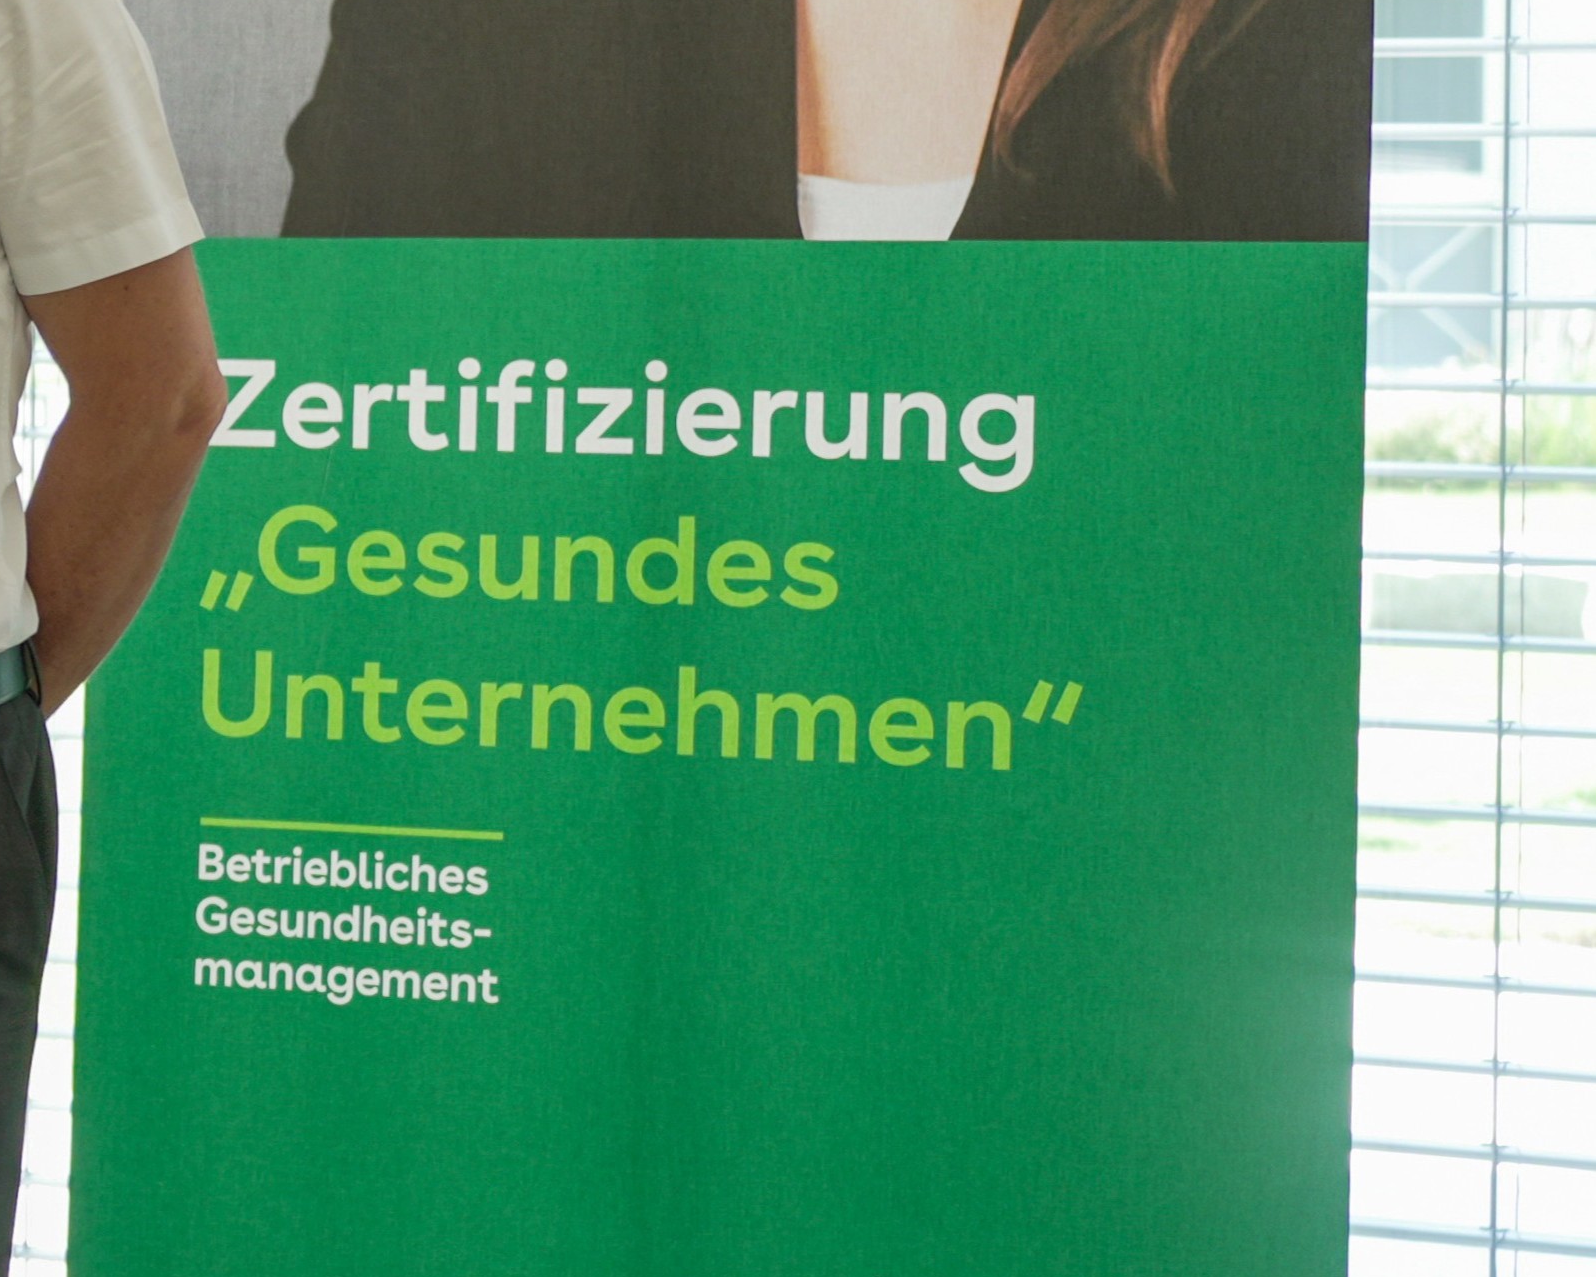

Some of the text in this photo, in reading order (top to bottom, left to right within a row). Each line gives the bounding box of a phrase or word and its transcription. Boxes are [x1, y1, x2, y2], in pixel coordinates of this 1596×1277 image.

[209, 357, 1036, 492] Zertifizierung
[199, 505, 839, 611] „Gesundes
[202, 649, 1082, 770] Unternehmen“
[198, 843, 489, 895] Betriebliches
[195, 896, 492, 949] Gesundheits-
[194, 957, 499, 1005] management
